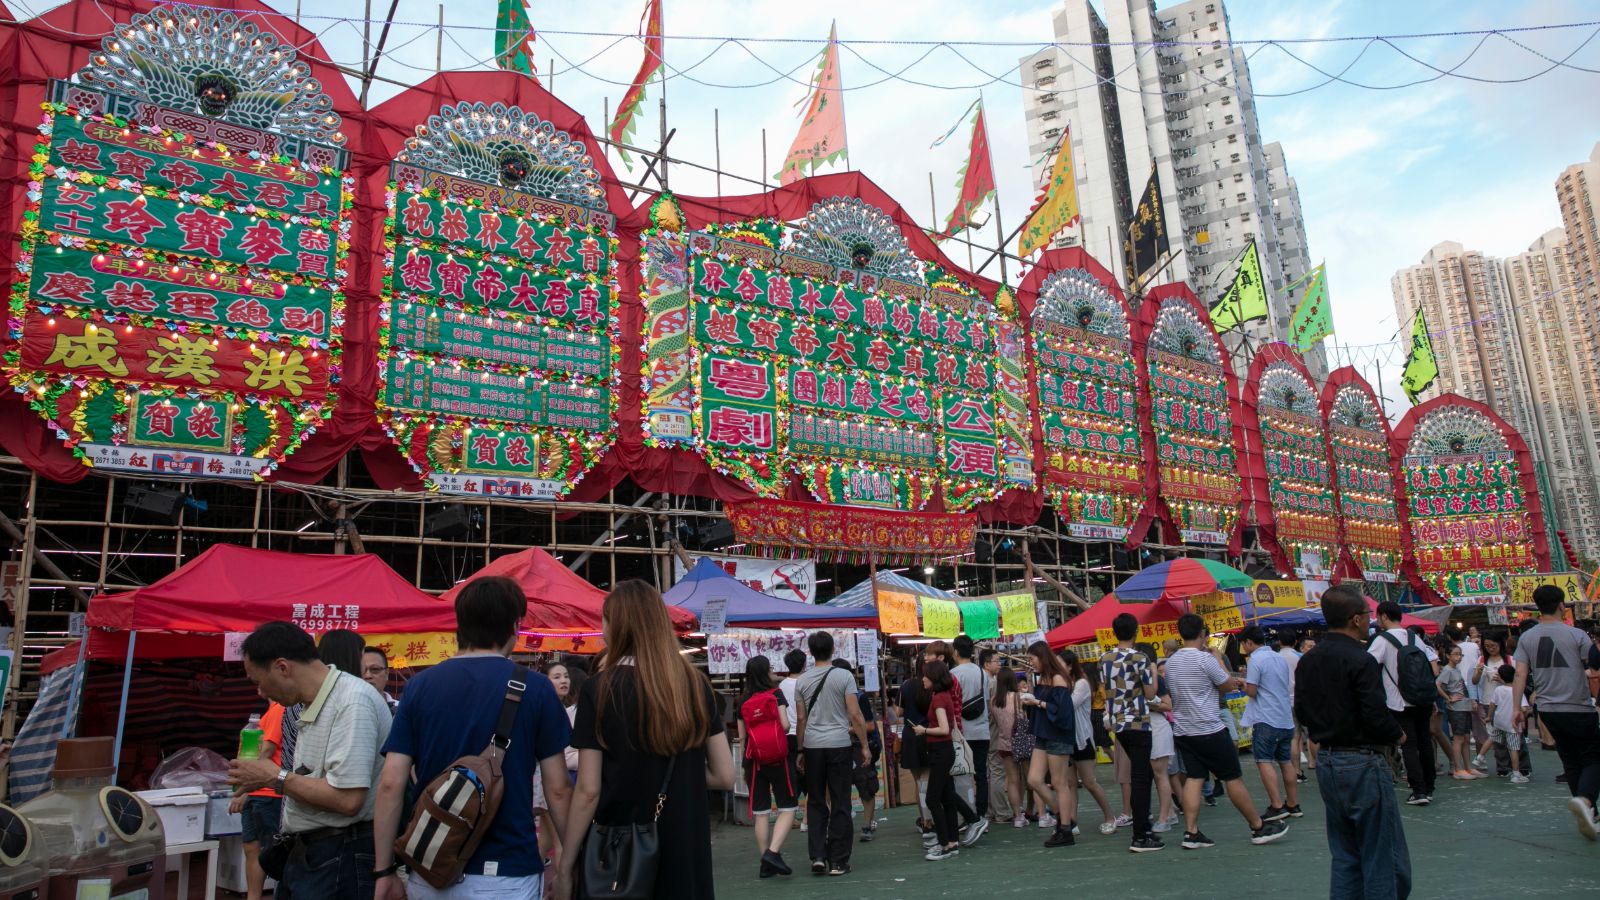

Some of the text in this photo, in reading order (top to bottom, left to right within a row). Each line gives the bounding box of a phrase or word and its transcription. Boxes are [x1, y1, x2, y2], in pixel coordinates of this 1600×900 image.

[54, 186, 97, 234] 女士
[297, 229, 331, 275] 恭賀
[292, 604, 360, 619] 富成工程
